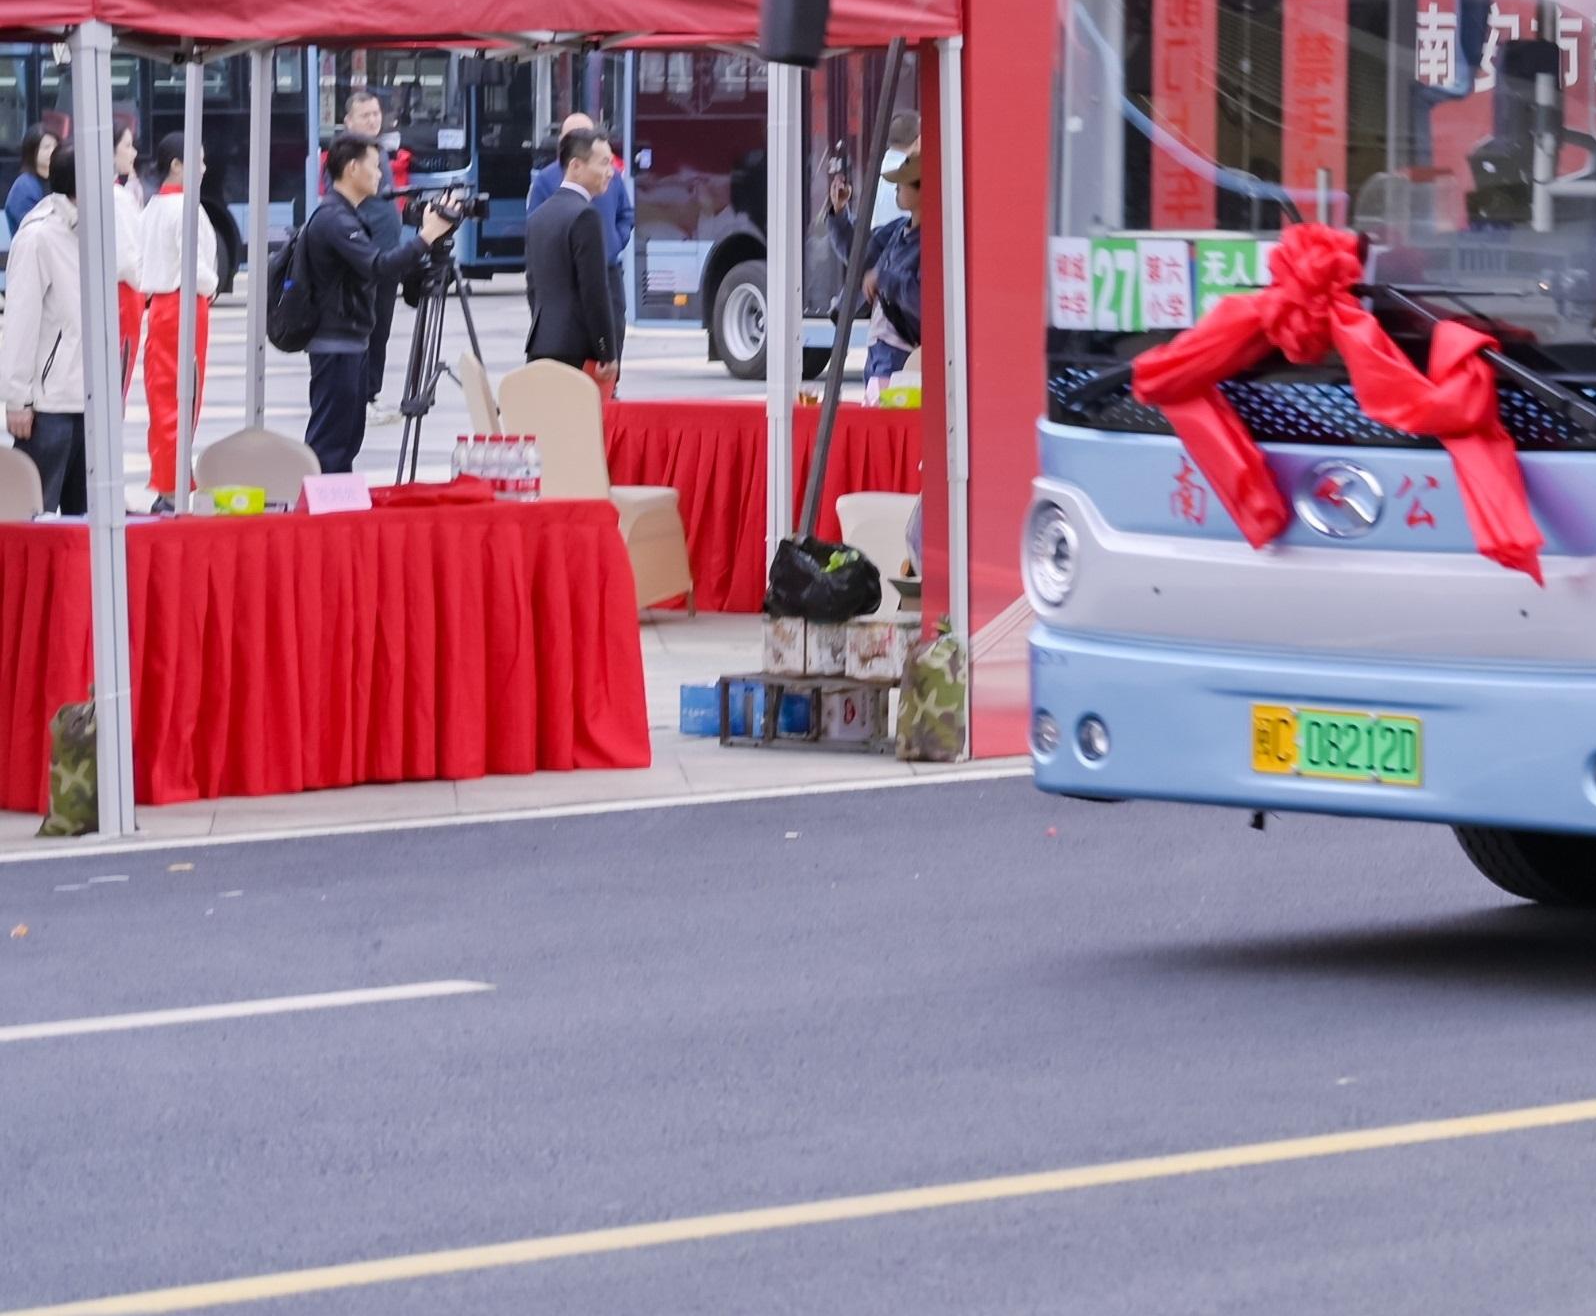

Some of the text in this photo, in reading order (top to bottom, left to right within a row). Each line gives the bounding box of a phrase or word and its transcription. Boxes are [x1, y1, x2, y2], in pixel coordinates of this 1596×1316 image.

[1093, 247, 1137, 331] 27
[1201, 250, 1252, 286] 无人
[1395, 475, 1439, 528] 公
